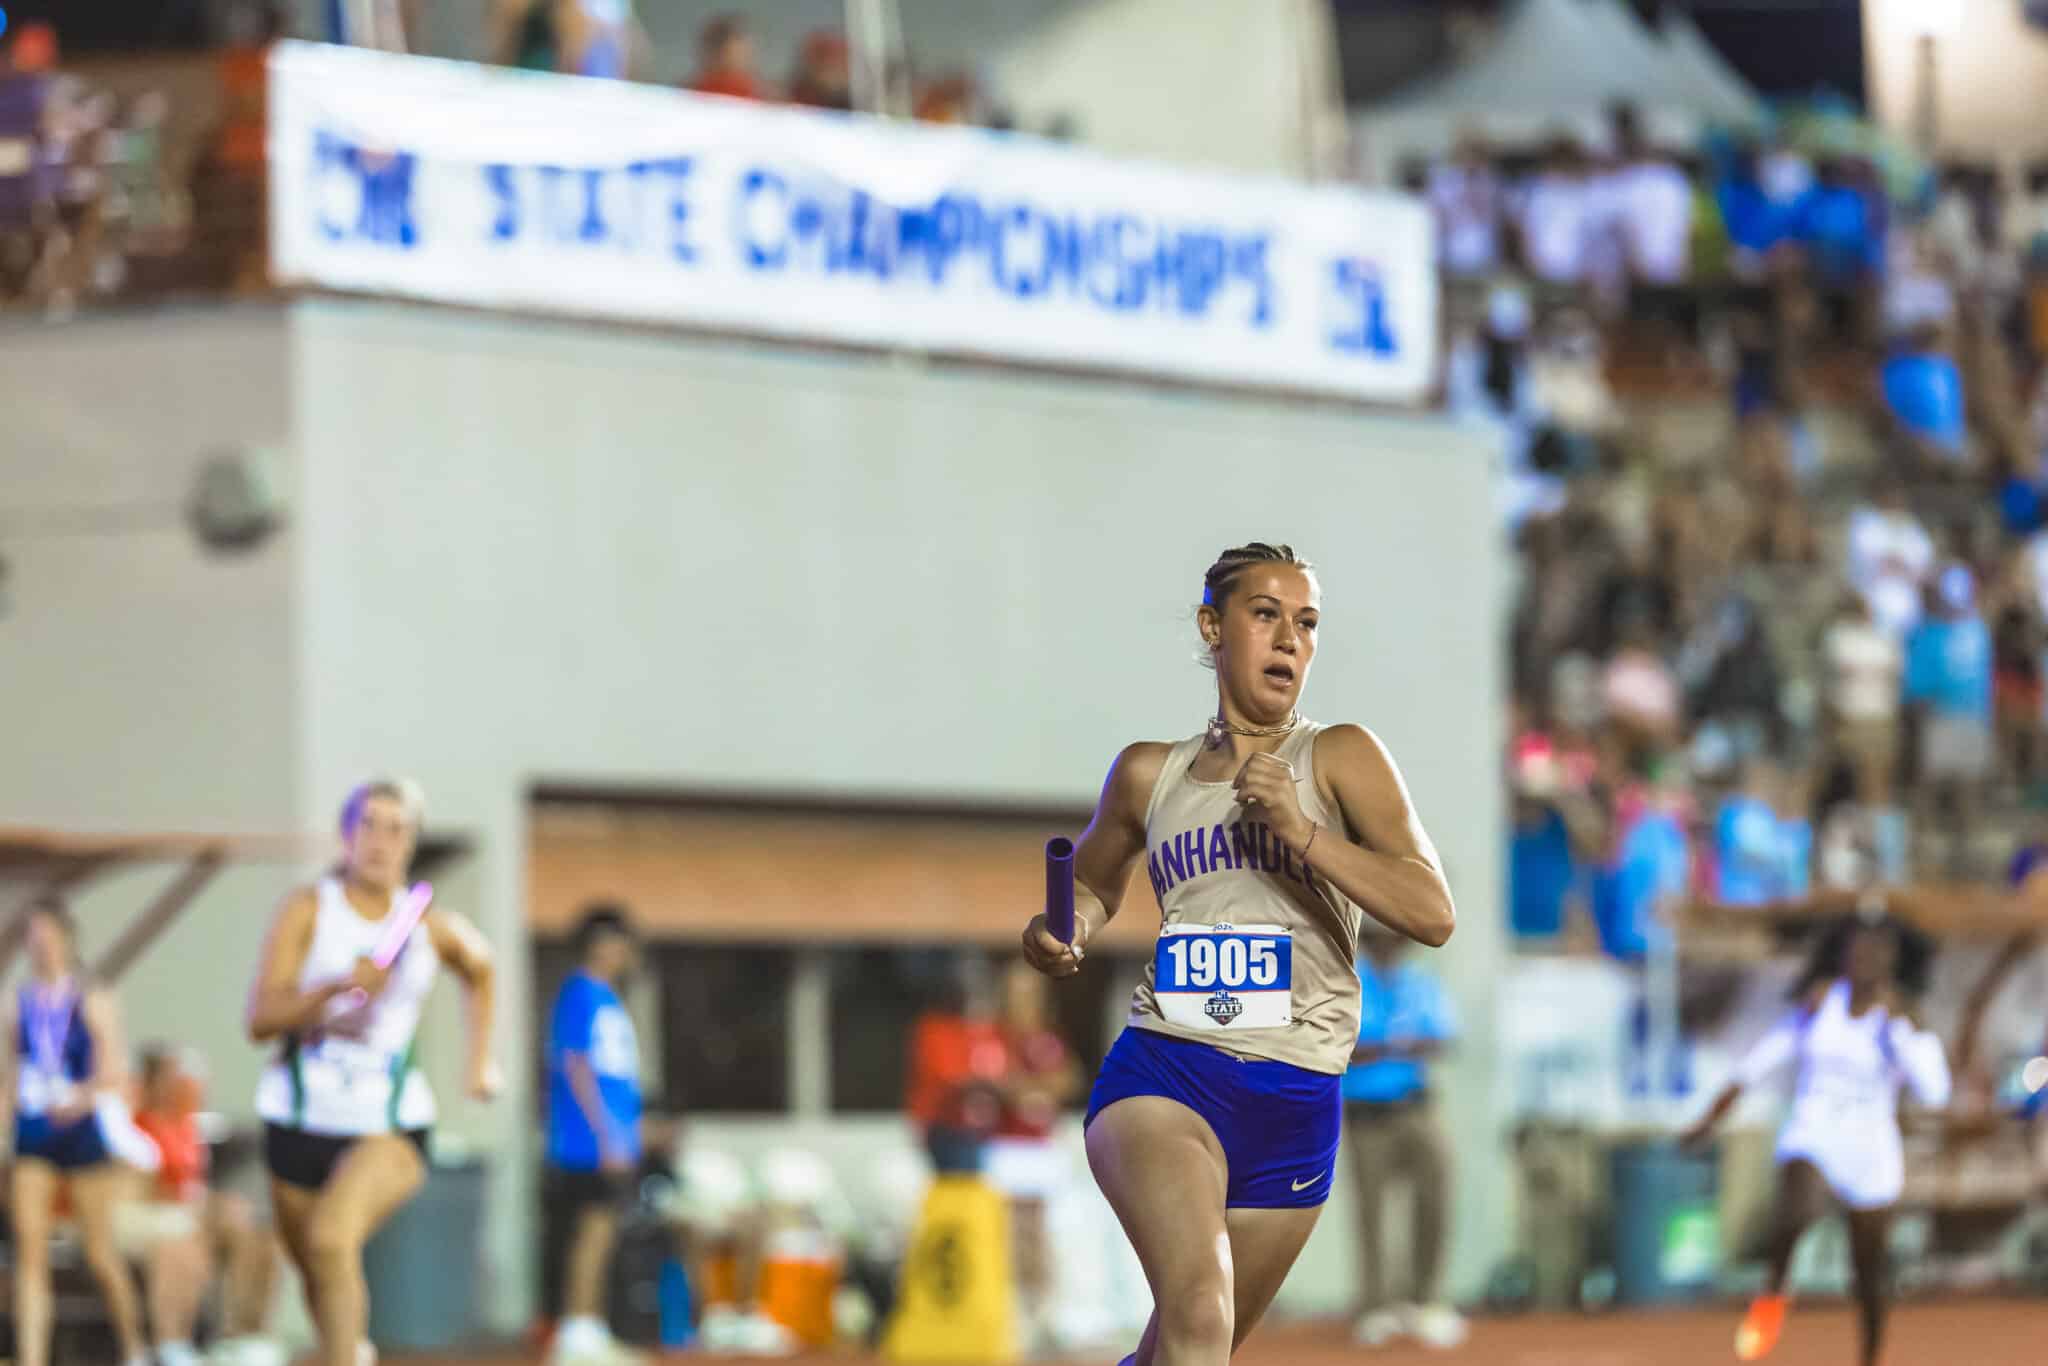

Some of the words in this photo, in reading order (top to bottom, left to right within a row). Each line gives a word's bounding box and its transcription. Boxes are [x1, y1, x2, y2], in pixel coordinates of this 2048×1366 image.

[486, 156, 696, 262] STATE
[738, 167, 1275, 328] CHAMPIONSHIPS
[1168, 938, 1278, 987] 1905
[1205, 1003, 1241, 1013] STATE
